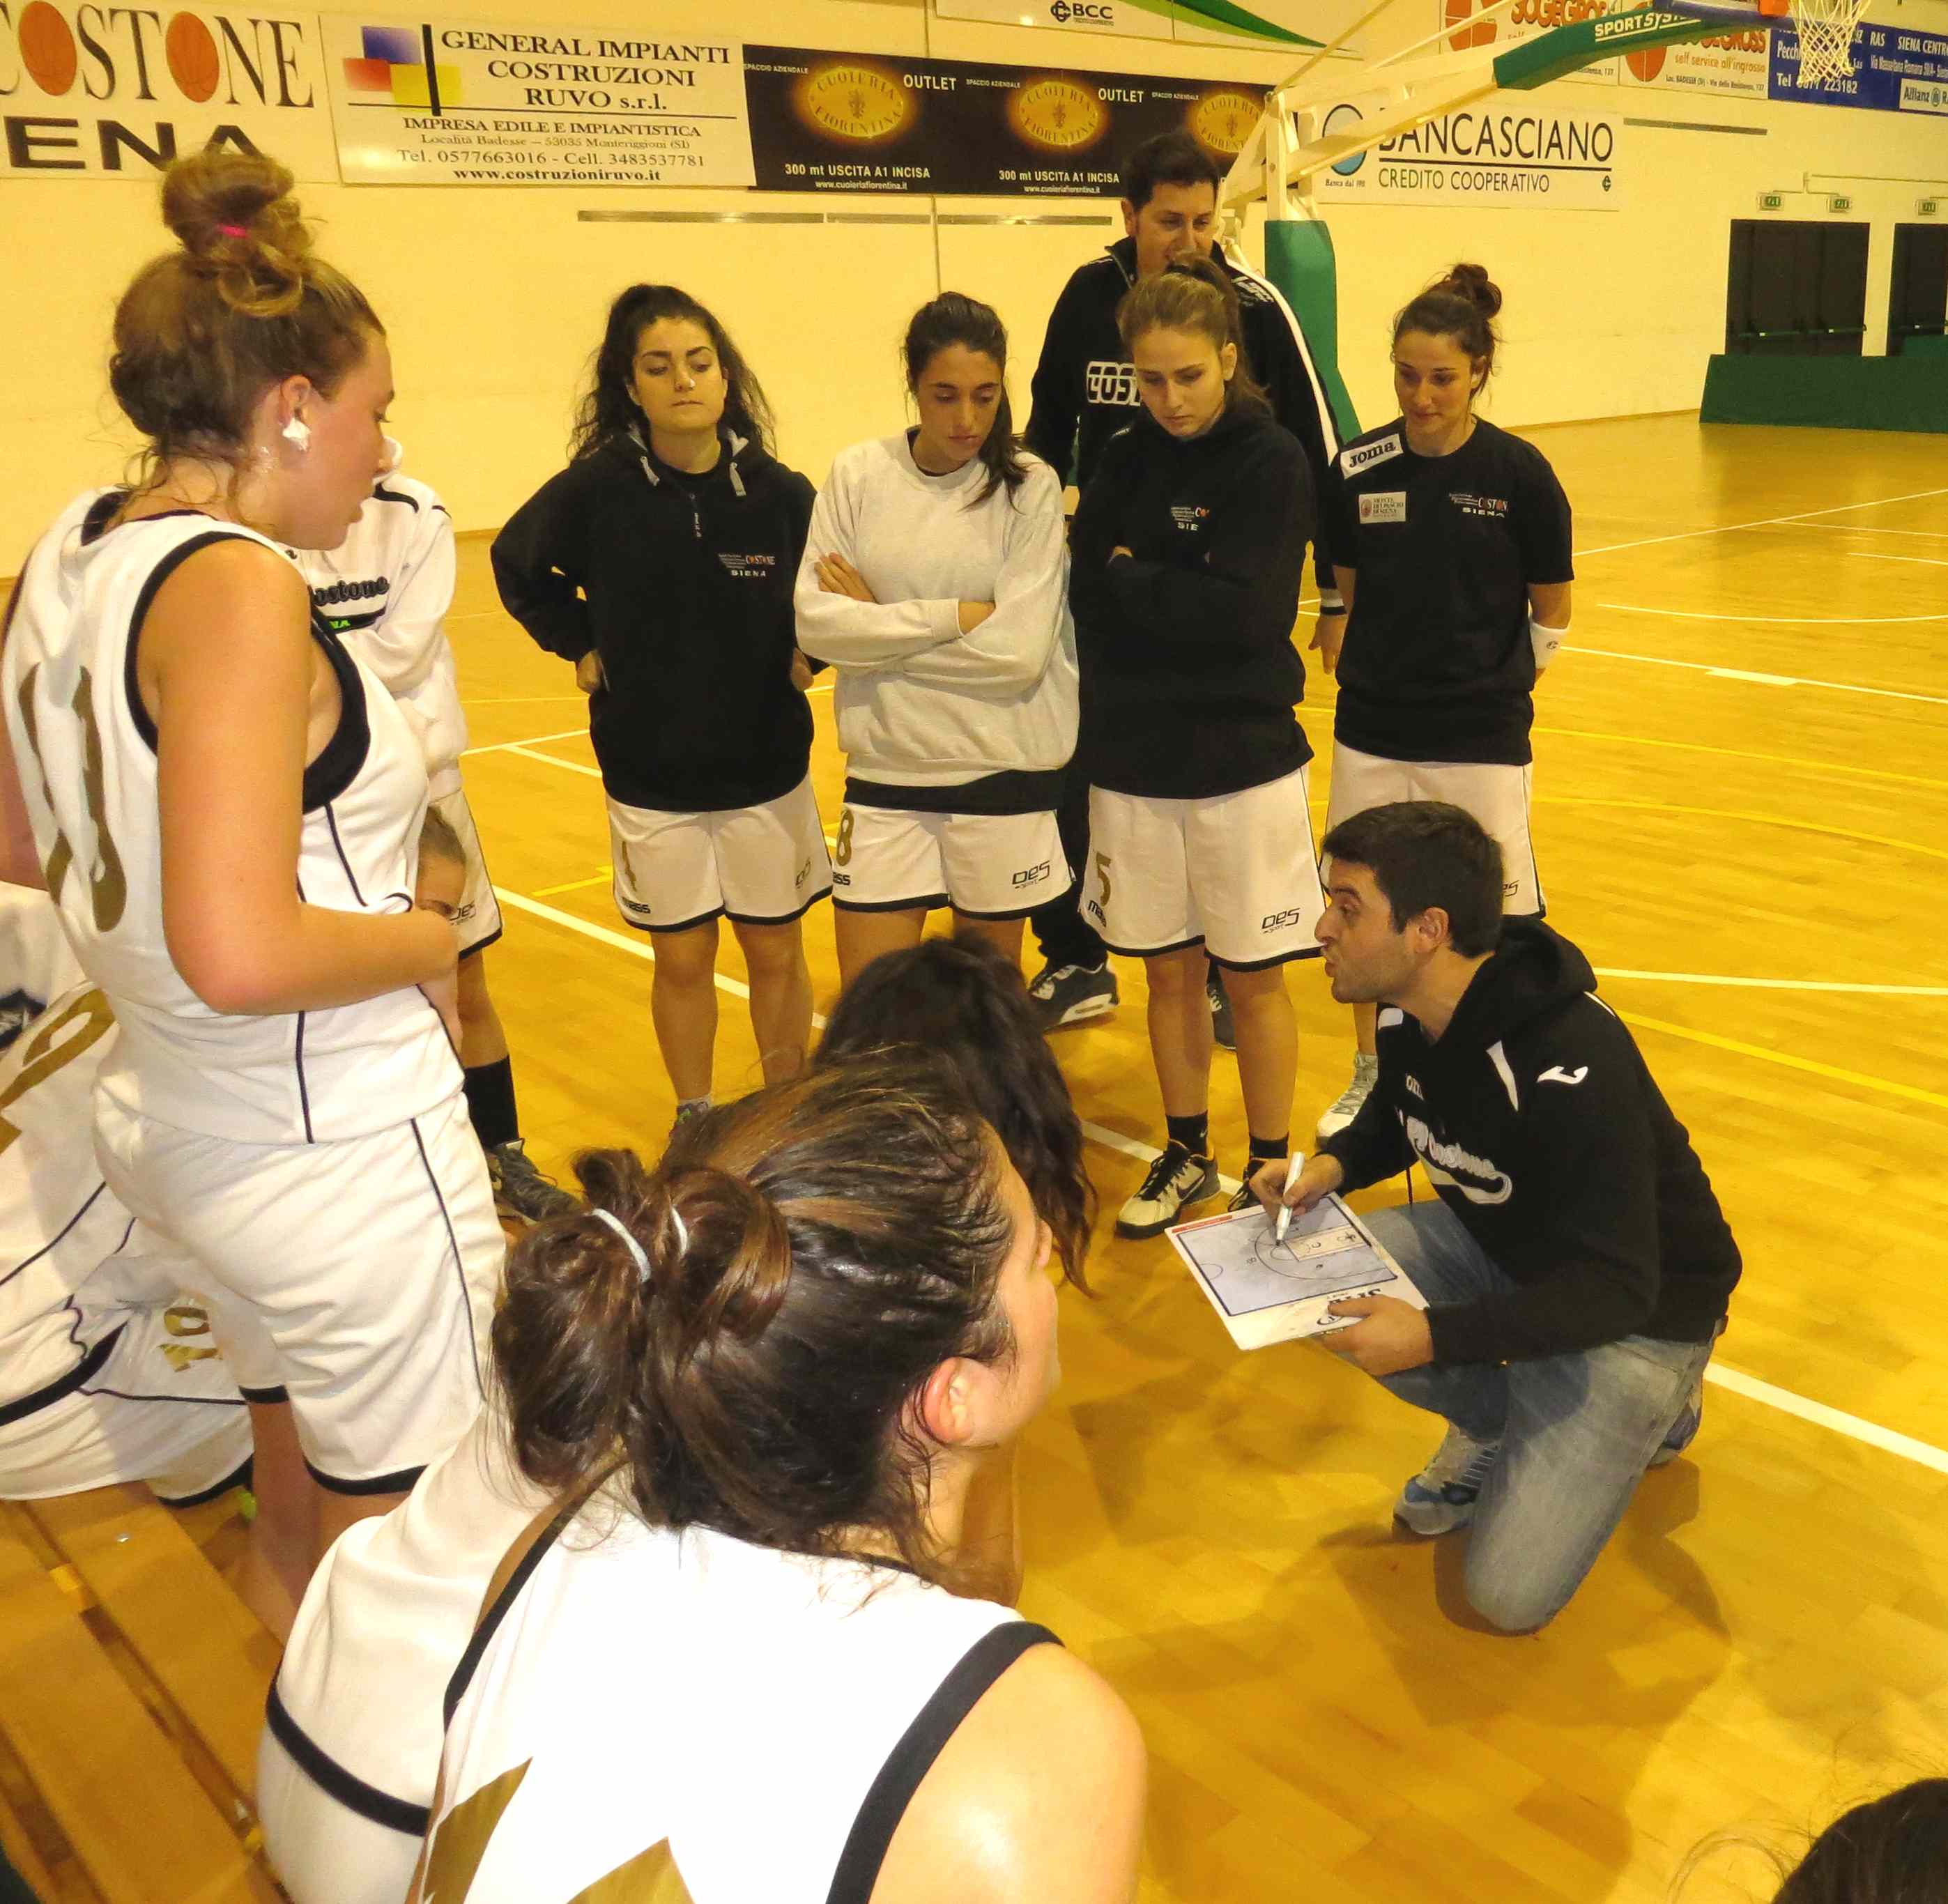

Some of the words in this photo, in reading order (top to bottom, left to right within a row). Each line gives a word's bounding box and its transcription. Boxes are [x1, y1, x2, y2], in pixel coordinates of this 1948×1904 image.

[1073, 3, 1113, 20] BCC
[441, 30, 591, 56] GENERAL
[597, 40, 730, 64] IMPIANTI
[1871, 31, 1885, 47] RAS
[1898, 36, 1921, 53] SIENA
[1675, 52, 1689, 67] self
[1692, 55, 1719, 68] service
[488, 60, 696, 86] COSTRUZIONI
[1777, 72, 1792, 88] Tel
[903, 74, 957, 91] OUTLET
[524, 88, 611, 108] RUVO
[620, 93, 667, 110] s.r.l.
[1098, 87, 1144, 104] OUTLET
[1903, 86, 1929, 103] Allianz
[402, 117, 489, 132] IMPRESA
[493, 121, 550, 133] EDILE
[553, 122, 565, 133] E
[570, 122, 701, 137] IMPIANTISTICA
[397, 149, 432, 162] Tel.
[437, 150, 547, 164] 0577663016
[564, 152, 602, 165] Cell.
[608, 153, 704, 167] 3483537781
[453, 169, 661, 181] www.costruzioniruvo.it
[785, 164, 806, 175] 300
[810, 165, 825, 176] mt
[828, 164, 871, 177] USCITA
[874, 167, 888, 178] A1
[892, 167, 930, 178] INCISA
[999, 170, 1016, 181] 300
[1035, 171, 1070, 182] USCITA
[1073, 172, 1084, 183] A1
[1087, 172, 1119, 183] INCISA
[1379, 168, 1443, 190] CREDITO
[1450, 171, 1549, 193] COOPERATIVO
[837, 809, 854, 866] 8
[1095, 852, 1111, 906] 5
